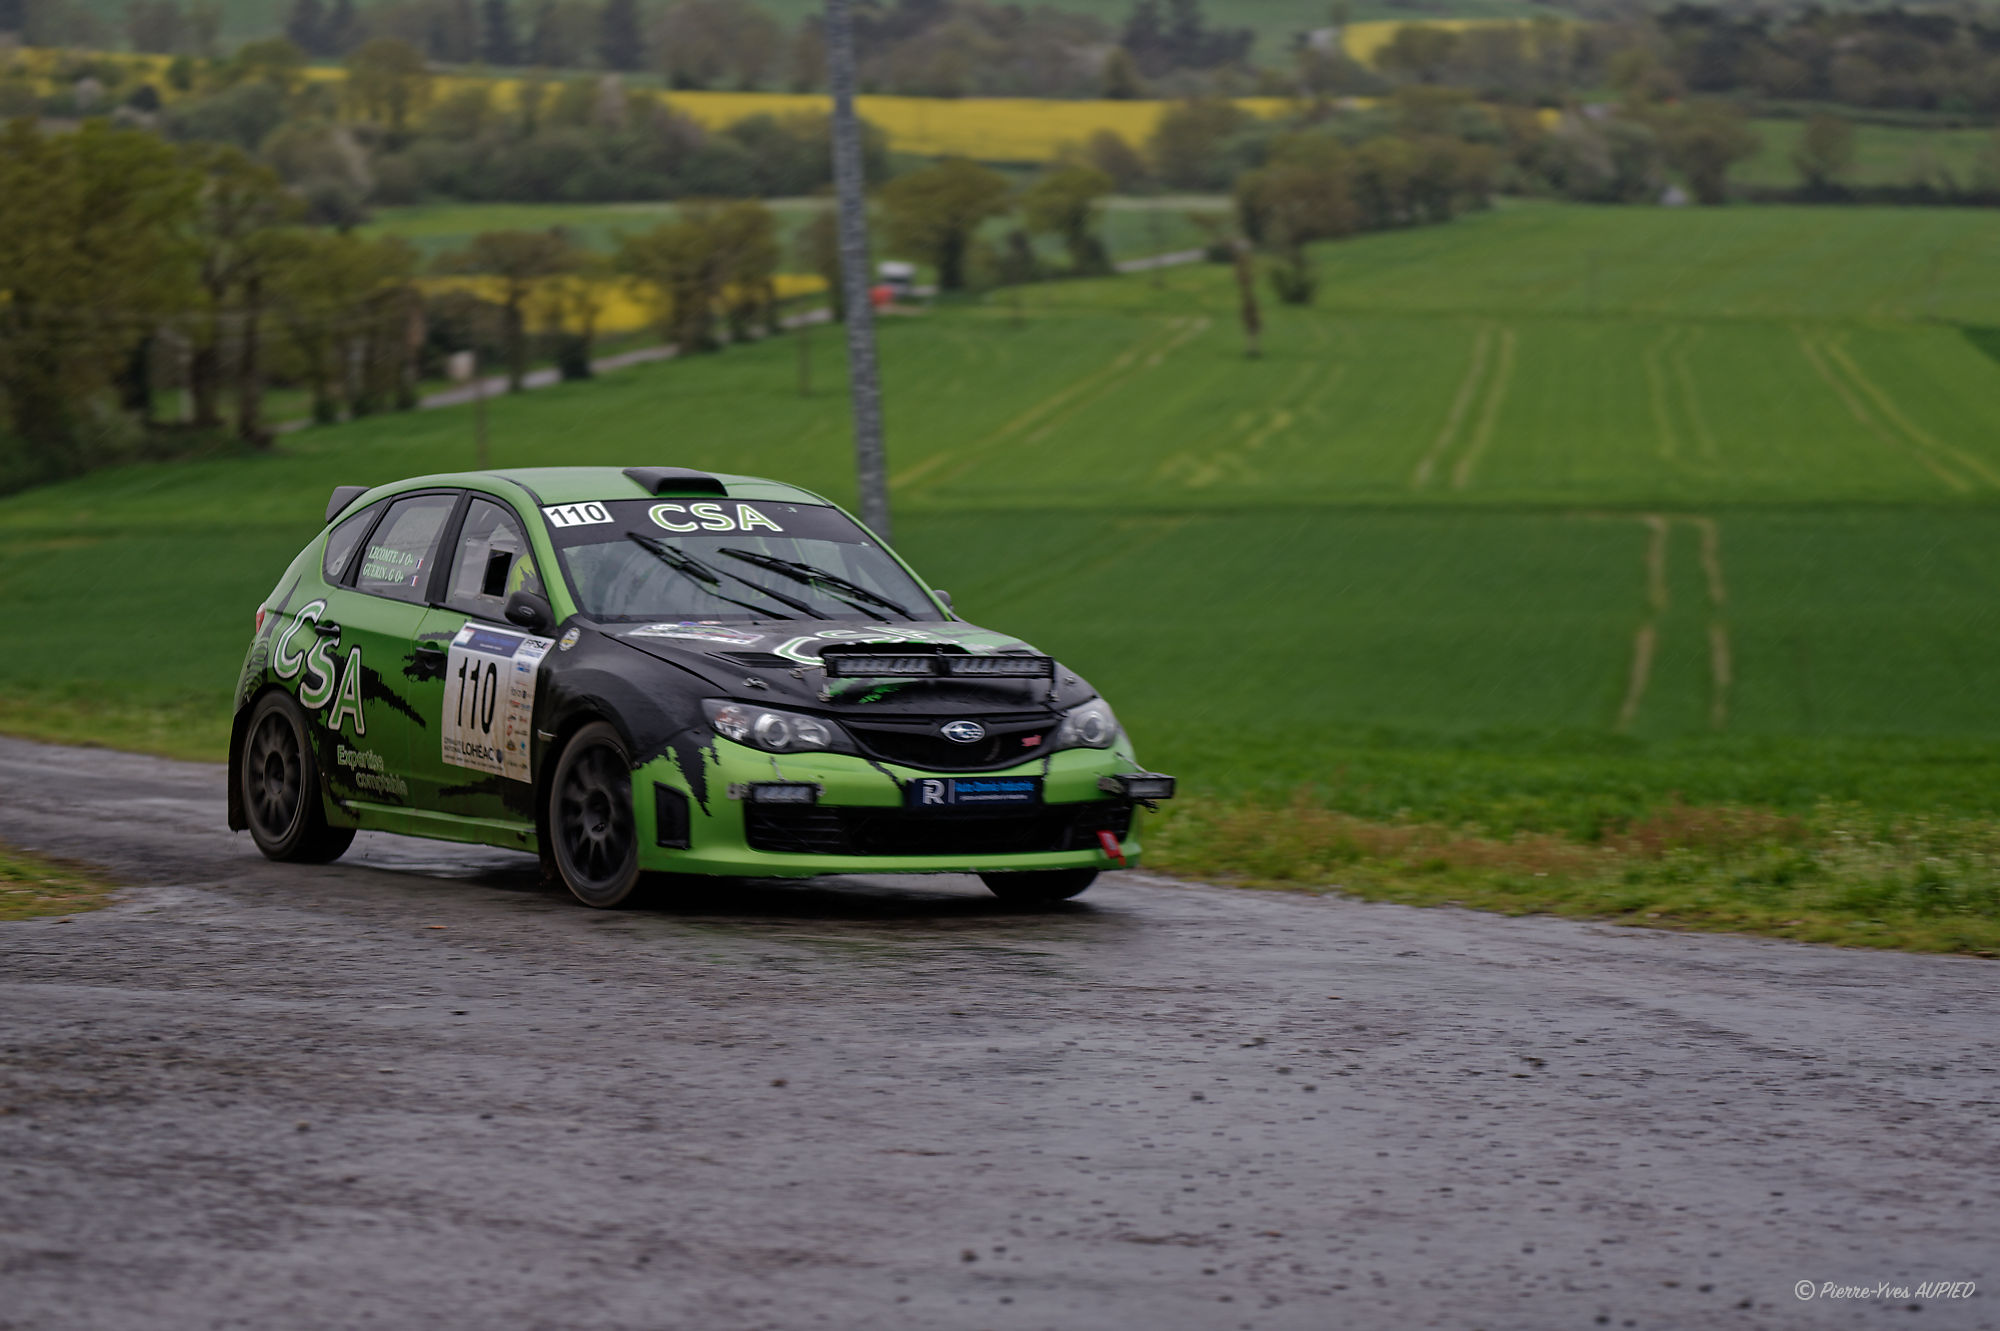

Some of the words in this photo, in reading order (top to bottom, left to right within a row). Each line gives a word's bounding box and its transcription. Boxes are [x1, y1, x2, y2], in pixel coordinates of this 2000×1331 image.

[550, 504, 606, 525] 110
[649, 503, 784, 532] CSA
[273, 598, 366, 736] CSA
[457, 656, 497, 734] 110
[337, 744, 384, 771] Expertise
[356, 772, 408, 796] comptable
